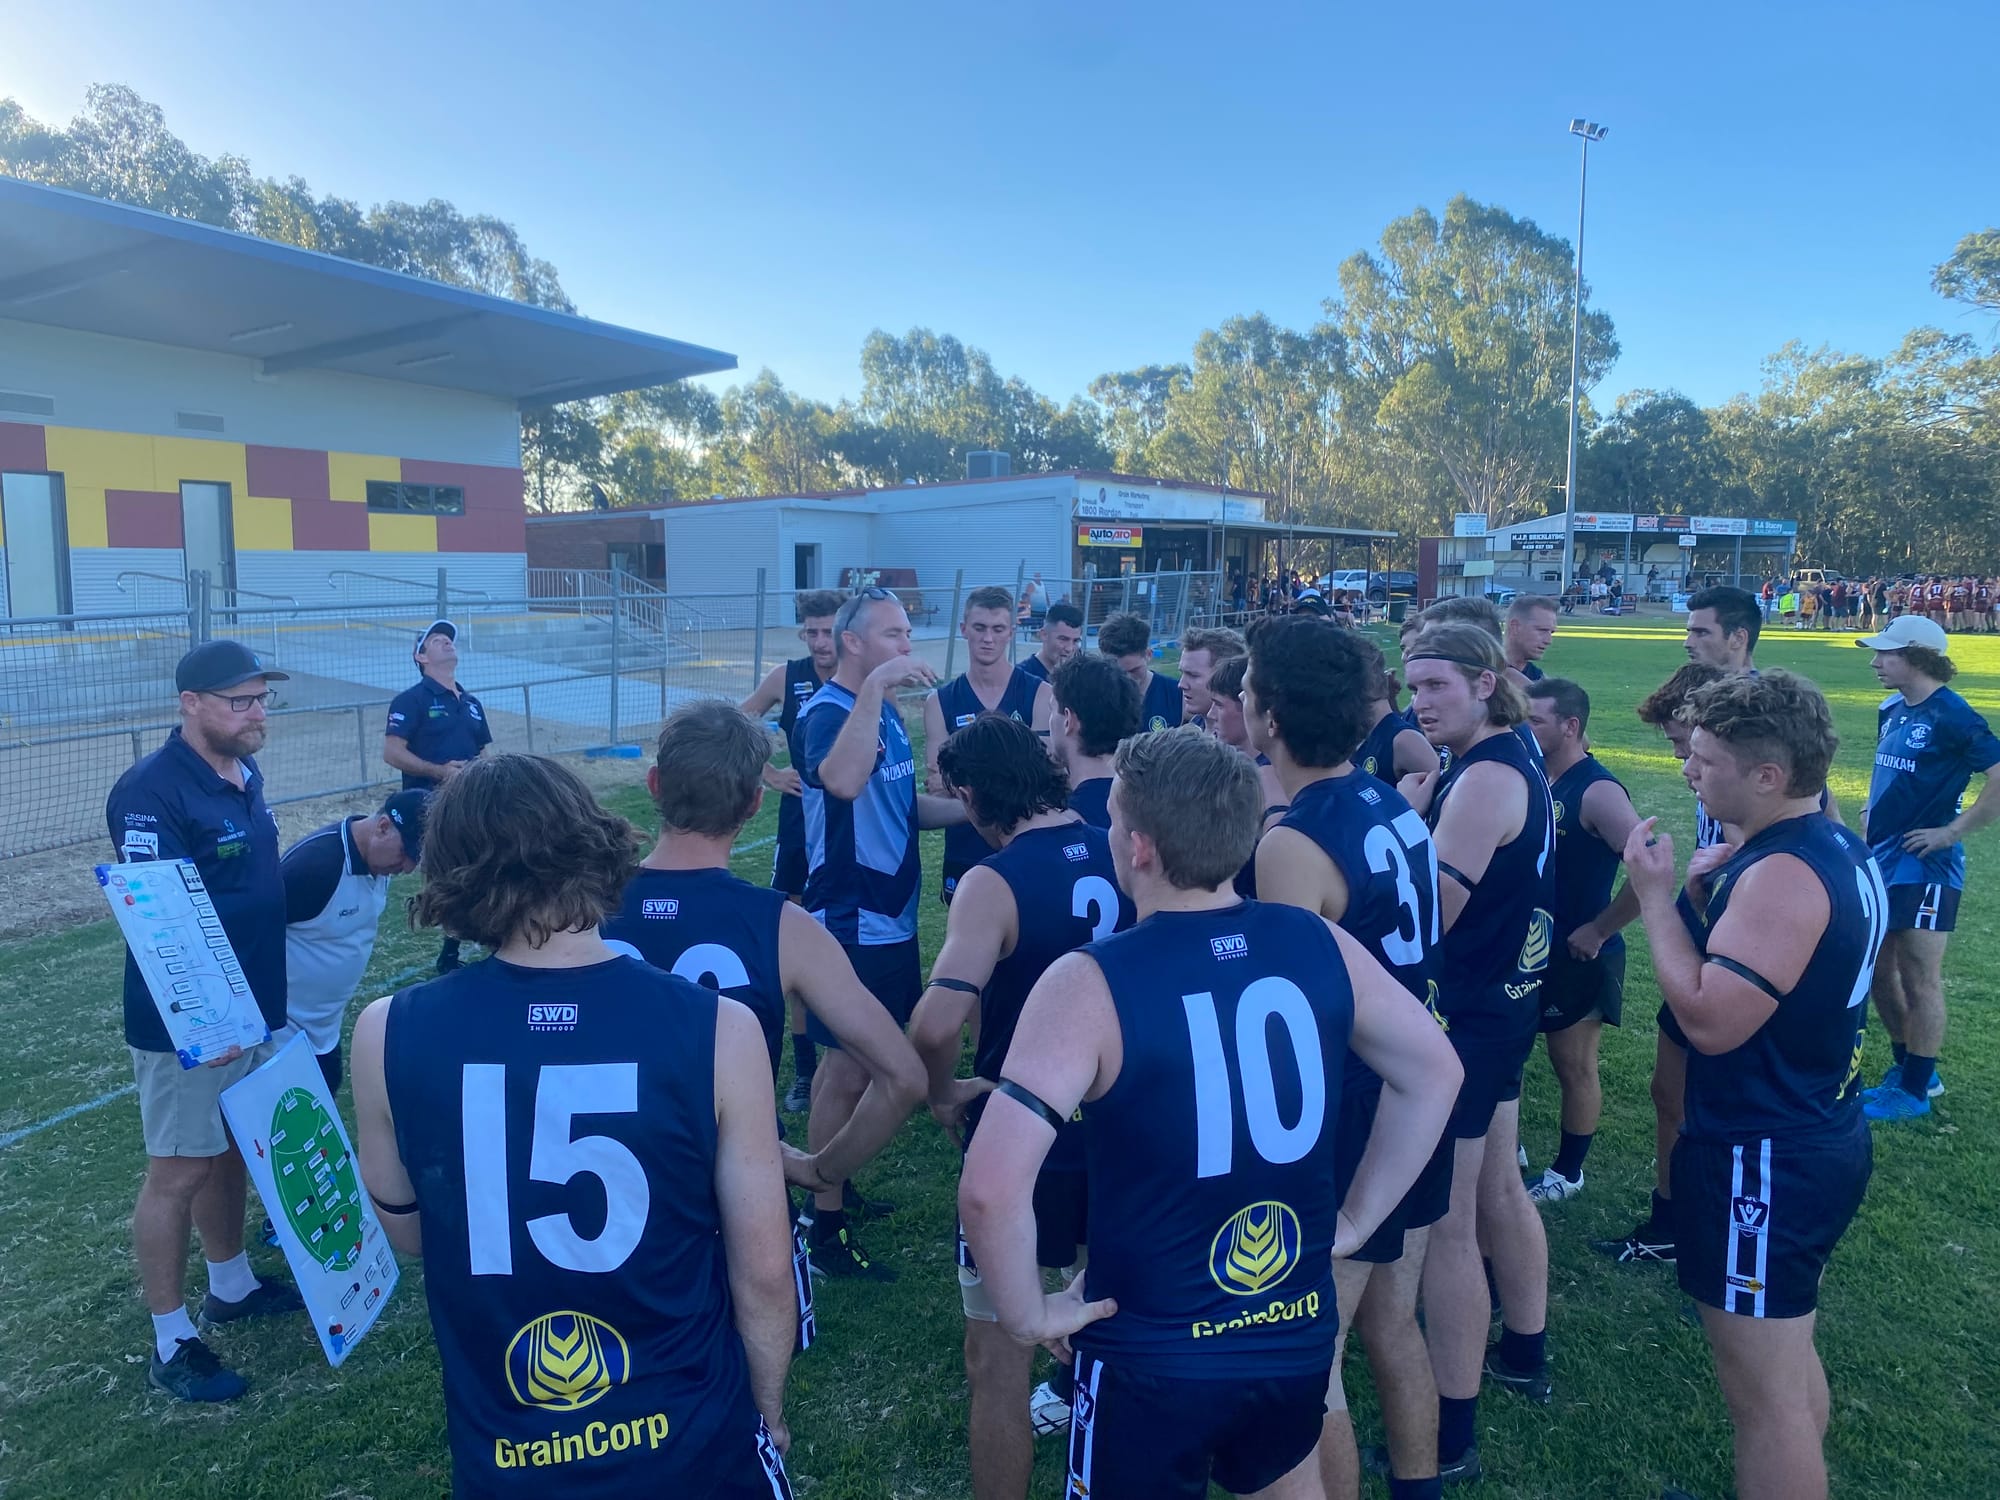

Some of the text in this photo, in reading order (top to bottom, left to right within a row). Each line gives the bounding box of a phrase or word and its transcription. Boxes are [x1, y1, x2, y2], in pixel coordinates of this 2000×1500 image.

[1065, 845, 1087, 858] SWD
[1364, 808, 1439, 967] 37
[644, 901, 676, 913] SWD
[1213, 936, 1245, 953] SWD
[531, 1006, 575, 1022] SWD
[1181, 976, 1326, 1178] 10
[462, 1062, 650, 1275] 15
[495, 1412, 669, 1469] GrainCorp
